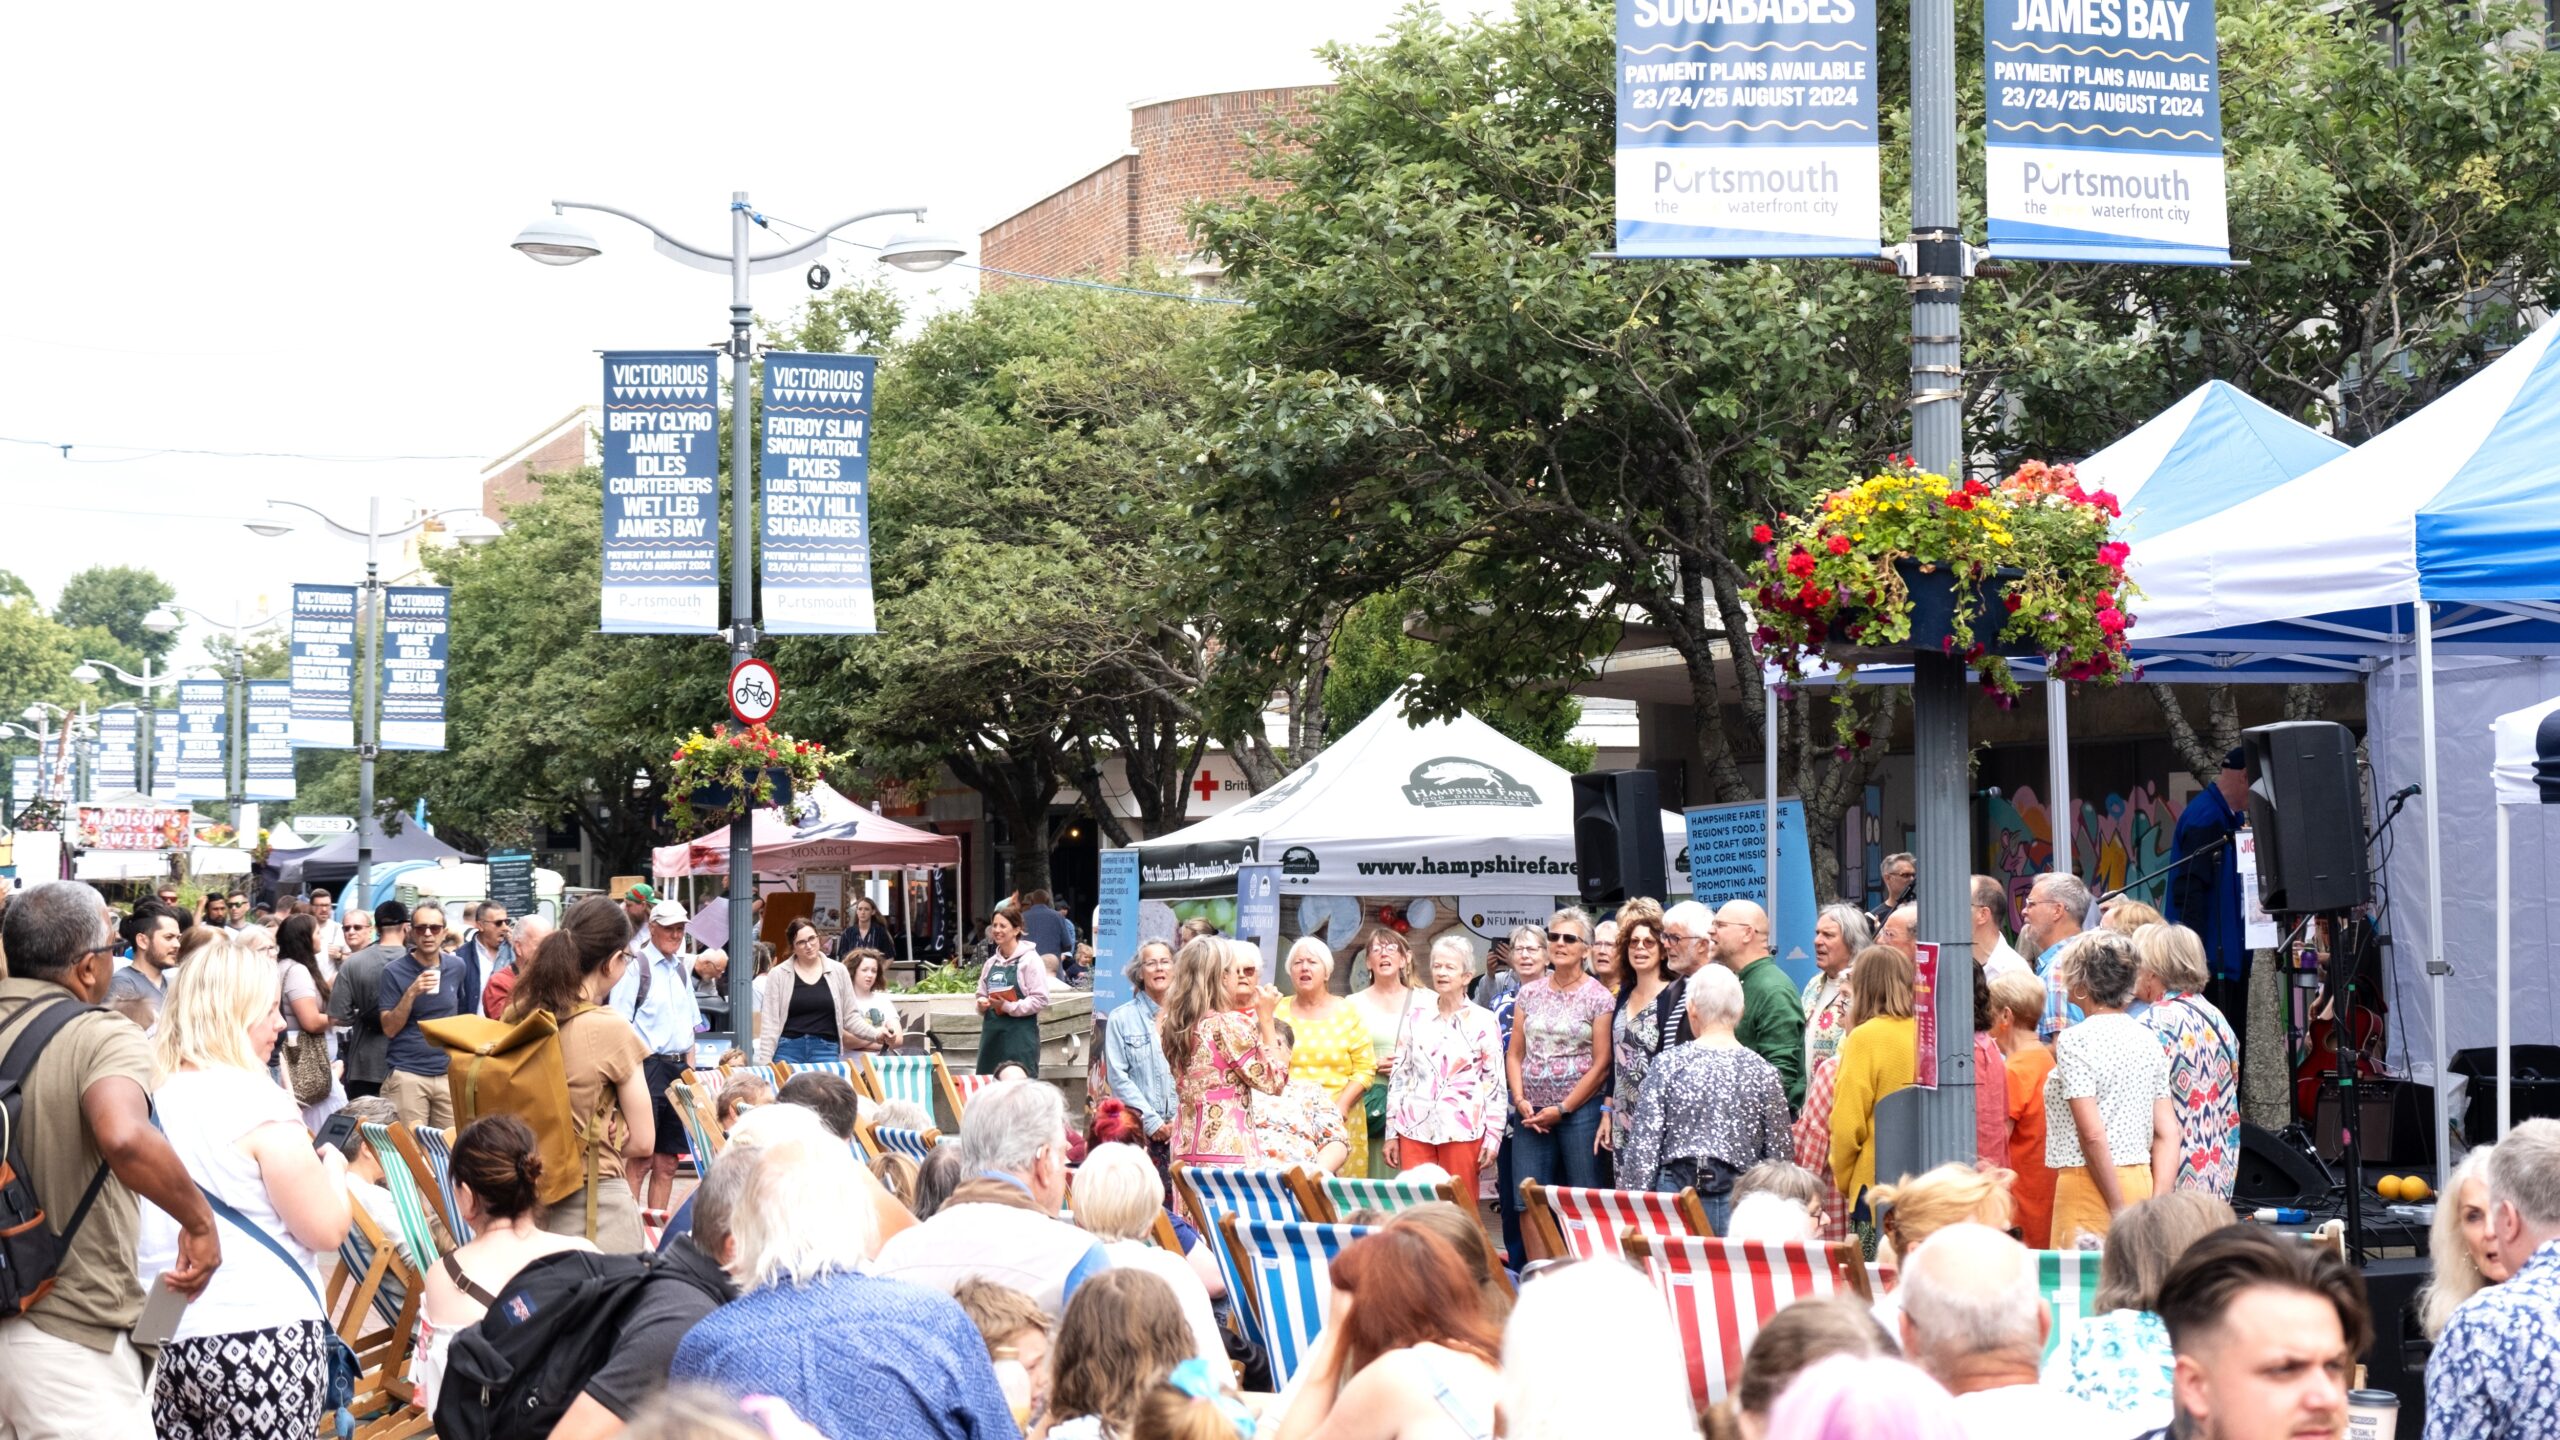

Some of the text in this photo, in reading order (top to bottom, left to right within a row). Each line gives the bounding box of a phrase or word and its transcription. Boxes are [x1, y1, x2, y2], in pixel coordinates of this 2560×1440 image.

[2011, 0, 2190, 42] JAMES BAY
[1625, 61, 1866, 84] PAYMENT PLANS AVAILABLE
[1994, 61, 2210, 93] PAYMENT PLANS AVAILABLE
[1632, 86, 1859, 110] 23/24/25 AUGUST 2024
[2001, 87, 2205, 118] 23/24/25 AUGUST 2024
[1654, 199, 1679, 214] the
[1728, 198, 1808, 214] waterfront
[1813, 197, 1839, 216] city
[2024, 199, 2048, 215] the
[2092, 204, 2164, 220] waterfront
[2168, 205, 2190, 225] city
[612, 364, 709, 386] VICTORIOUS
[773, 366, 864, 390] VICTORIOUS
[609, 412, 713, 432] BIFFY CLYRO
[768, 417, 863, 439] FATBOY SLIM
[627, 433, 695, 454] JAMIE T
[767, 437, 862, 458] SNOW PATROL
[635, 455, 687, 477] IDLES
[788, 458, 841, 479] PIXIES
[609, 477, 713, 495] COURTEENERS
[767, 479, 861, 495] LOUIS TOMLINSON
[622, 497, 699, 517] WET LEG
[767, 495, 861, 518] BECKY HILL
[615, 518, 707, 539] JAMES BAY
[767, 518, 861, 539] SUGABABES
[607, 550, 715, 560] PAYMENT PLANS AVAILABLE
[654, 561, 688, 570] AUGUST
[688, 561, 711, 570] 2024
[389, 594, 445, 608] VICTORIOUS
[1411, 787, 1531, 799] HAMPSHIRE FARE
[86, 810, 182, 828] MADISON'S
[299, 820, 340, 830] TOILETS
[1691, 812, 1737, 826] HAMPSHIRE
[1739, 810, 1761, 821] FARE
[100, 832, 165, 847] SWEETS
[1692, 827, 1730, 839] REGION'S
[1732, 824, 1759, 834] FOOD,
[791, 845, 851, 858] MONARCH
[1693, 842, 1711, 852] AND
[1713, 839, 1740, 850] CRAFT
[1694, 855, 1712, 865] OUR
[1713, 852, 1737, 863] CORE
[1142, 865, 1155, 882] Out
[1155, 864, 1173, 882] there
[1173, 862, 1189, 880] with
[1189, 860, 1224, 882] Hampshire
[1695, 864, 1756, 878] CHAMPIONING,
[1696, 876, 1767, 890] PROMOTING AND
[1698, 891, 1754, 904] CELEBRATING
[1487, 917, 1544, 926] NFU Mutual
